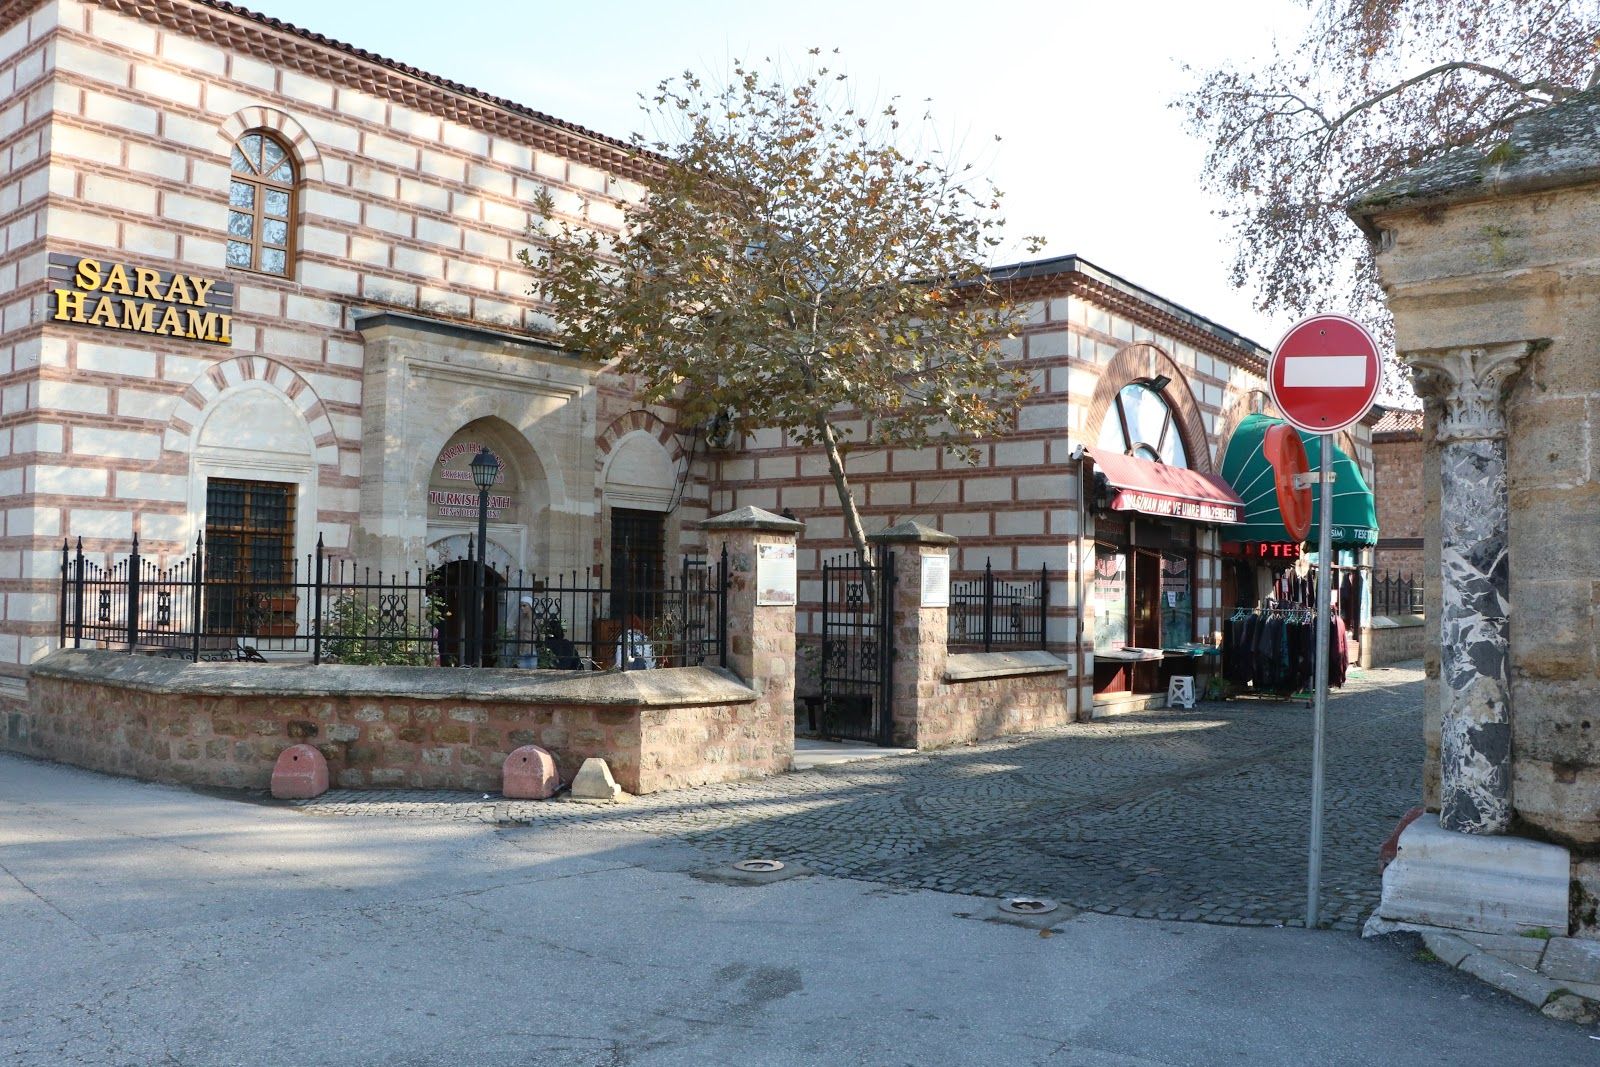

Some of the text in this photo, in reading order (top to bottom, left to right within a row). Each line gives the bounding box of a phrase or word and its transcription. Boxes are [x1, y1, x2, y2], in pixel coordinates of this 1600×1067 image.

[76, 258, 215, 307] SARAY
[54, 288, 232, 343] HAMAMI
[439, 443, 465, 466] SARAY
[430, 490, 480, 507] TURKISH
[1172, 501, 1182, 515] VE
